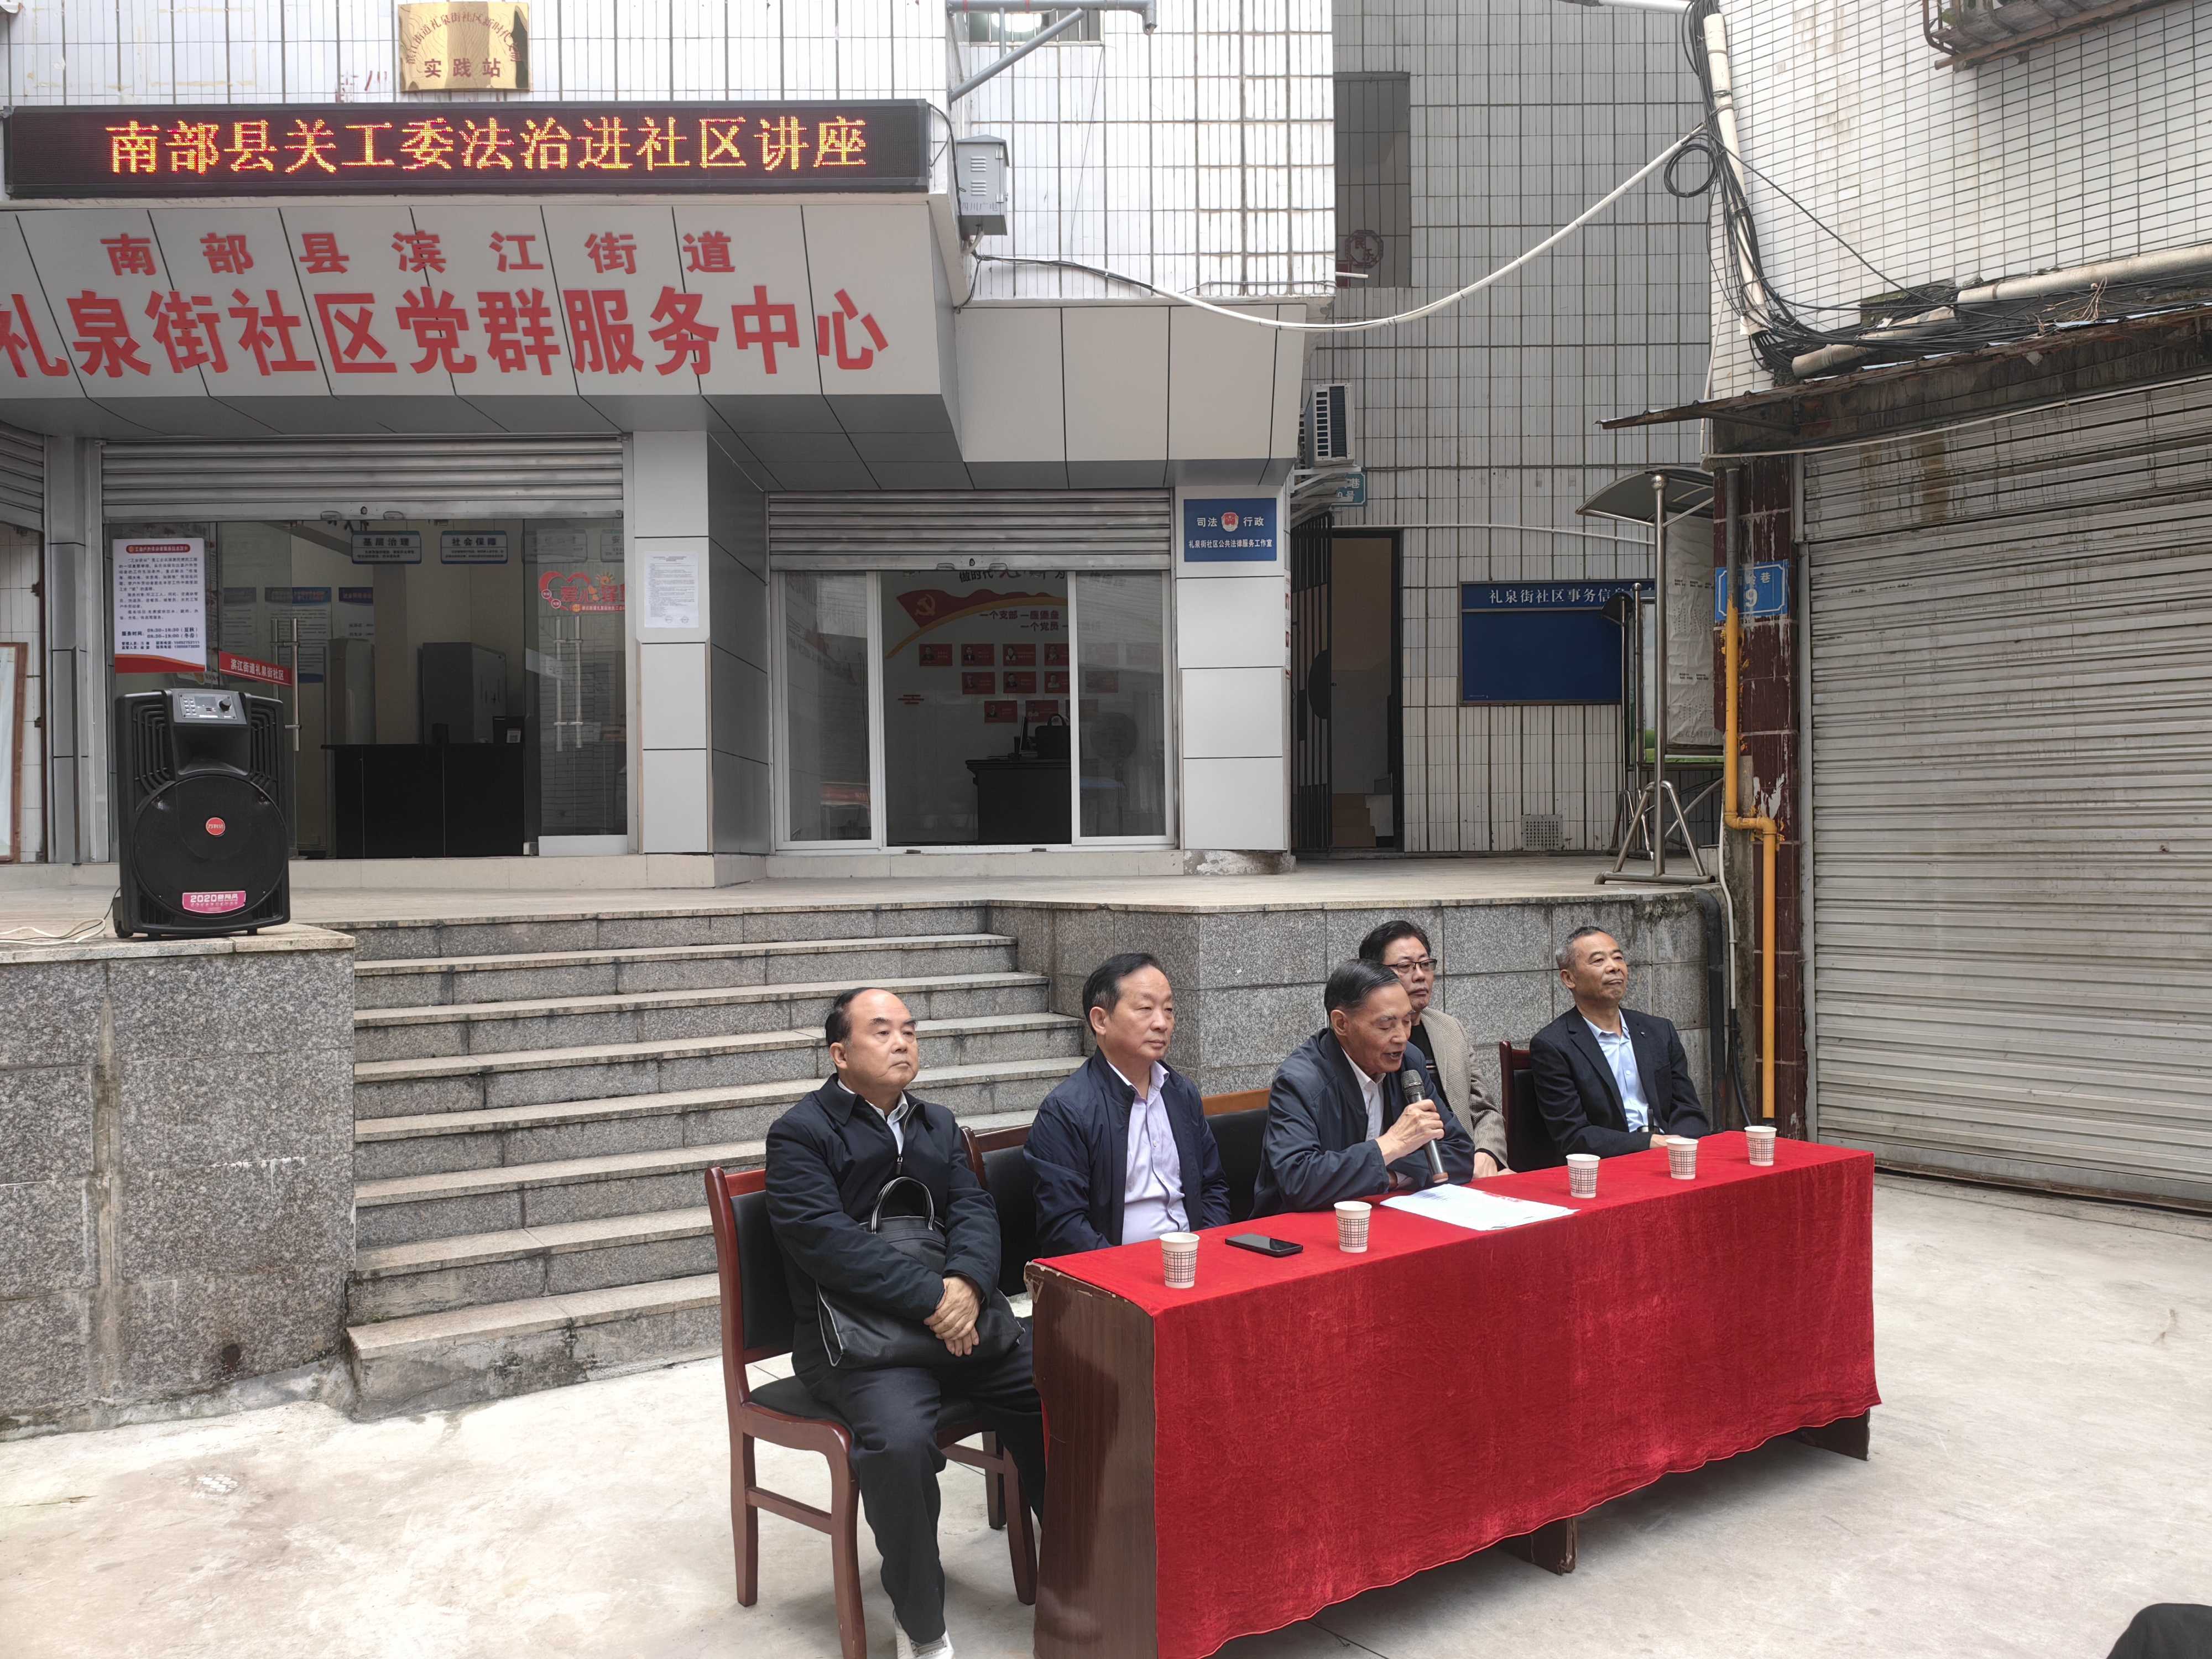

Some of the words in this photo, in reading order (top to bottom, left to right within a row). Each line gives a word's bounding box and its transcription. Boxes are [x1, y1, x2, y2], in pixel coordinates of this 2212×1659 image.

[424, 57, 501, 78] 实践站
[105, 116, 867, 175] 南部县关工委法治进社区讲座
[100, 230, 736, 276] 南部县滨江街道
[0, 285, 889, 378] 礼泉街社区党群服务中心
[1197, 517, 1217, 528] 司法
[1243, 517, 1264, 527] 行政
[1188, 539, 1272, 549] 礼泉街社区公共法律服务工作室
[1489, 587, 1652, 604] 礼泉街社区事务信
[1745, 588, 1758, 608] 9
[979, 611, 1018, 620] 一个支部
[1020, 622, 1059, 632] 一个党员
[230, 658, 284, 681] 滨江街道礼泉街社区
